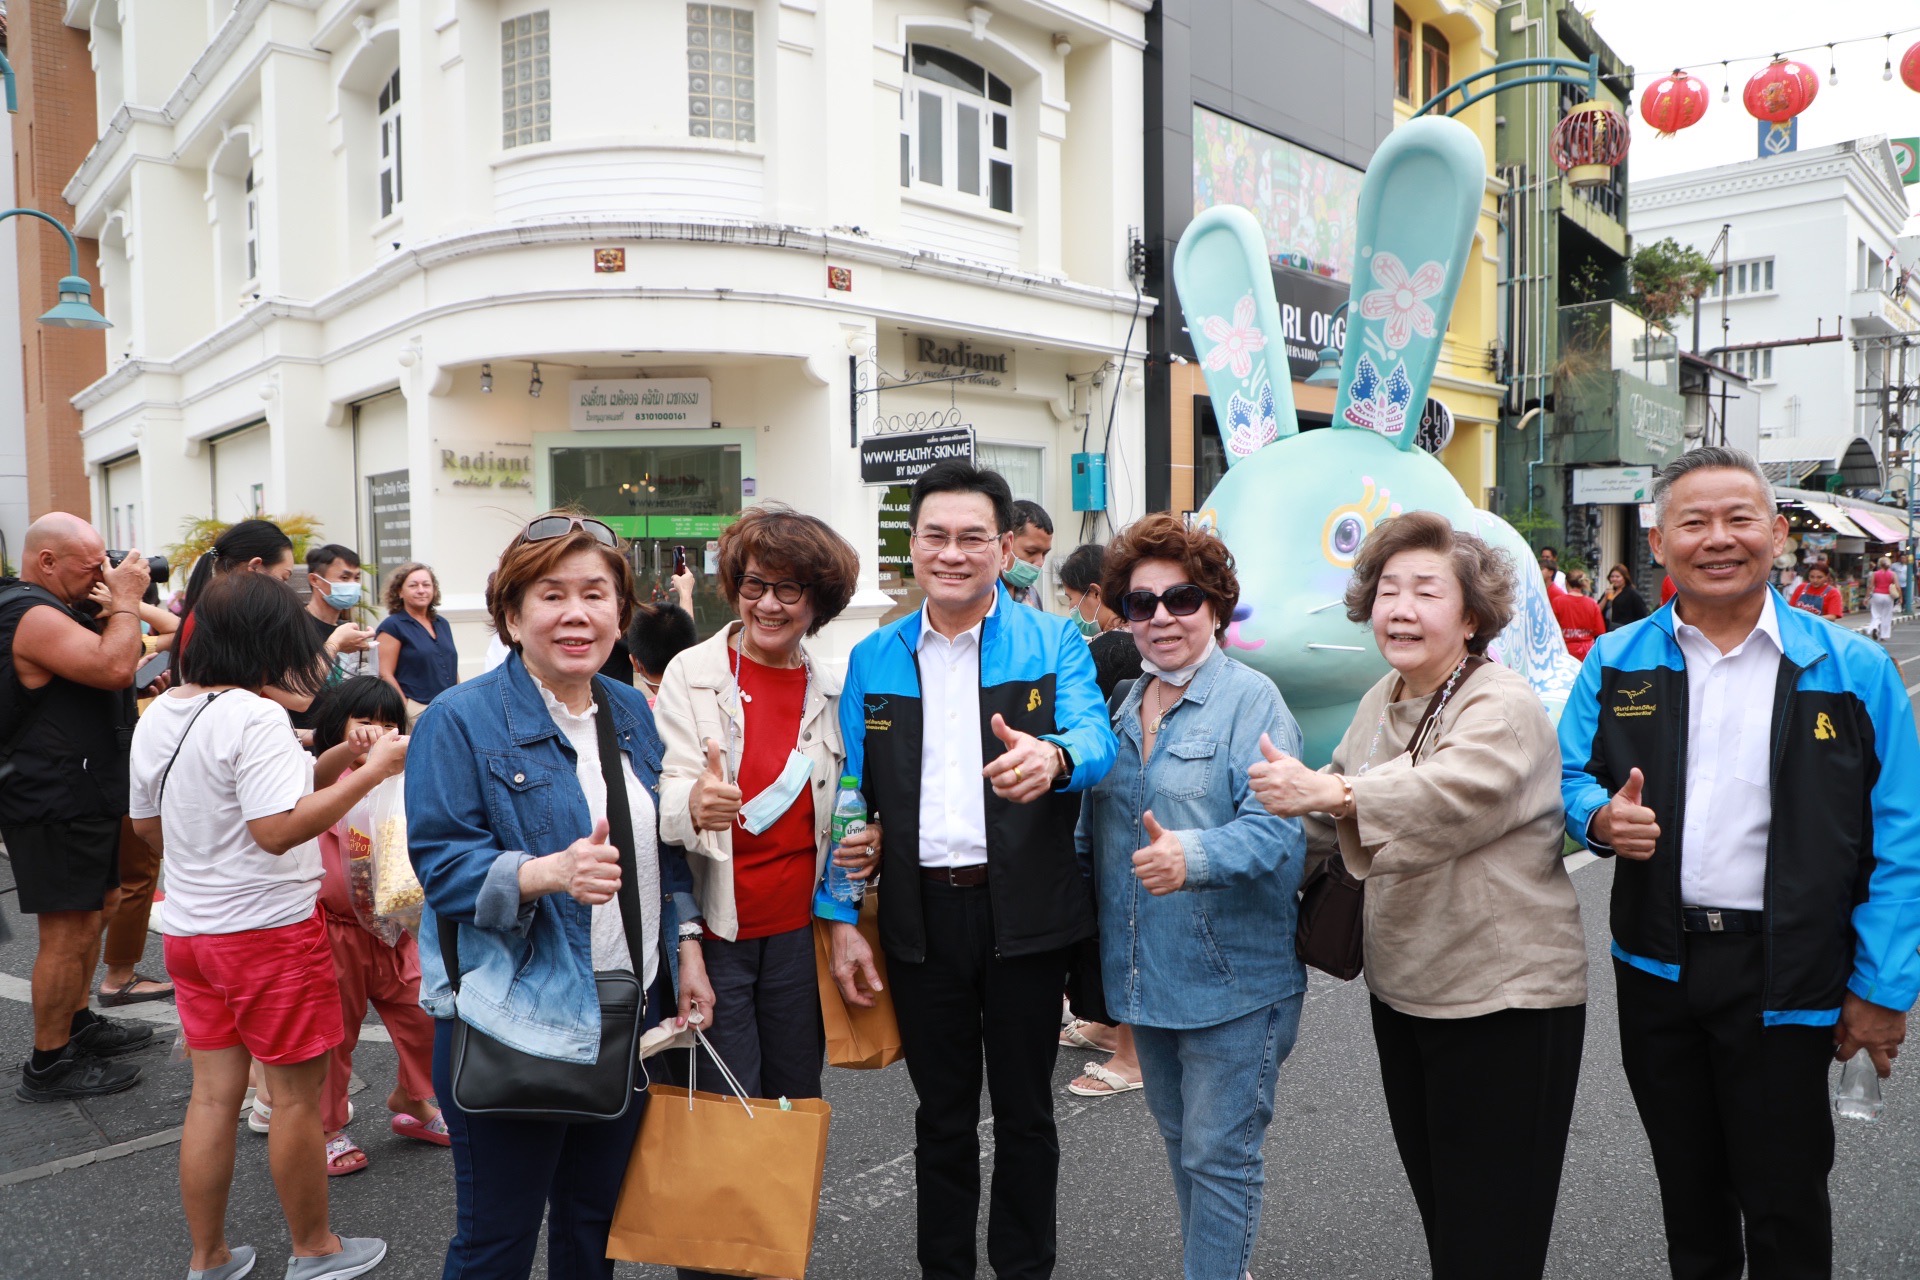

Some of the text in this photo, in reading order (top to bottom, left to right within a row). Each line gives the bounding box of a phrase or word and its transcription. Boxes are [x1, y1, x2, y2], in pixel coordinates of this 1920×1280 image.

[1283, 303, 1347, 350] RL ORG
[917, 337, 1008, 373] Radiant
[1286, 344, 1319, 362] TERNATION
[635, 412, 687, 421] 83101000161
[440, 449, 531, 472] Radiant
[863, 443, 970, 465] WWW.HEALTHY-SKIN.ME
[896, 466, 905, 476] BY
[895, 504, 911, 512] LASE
